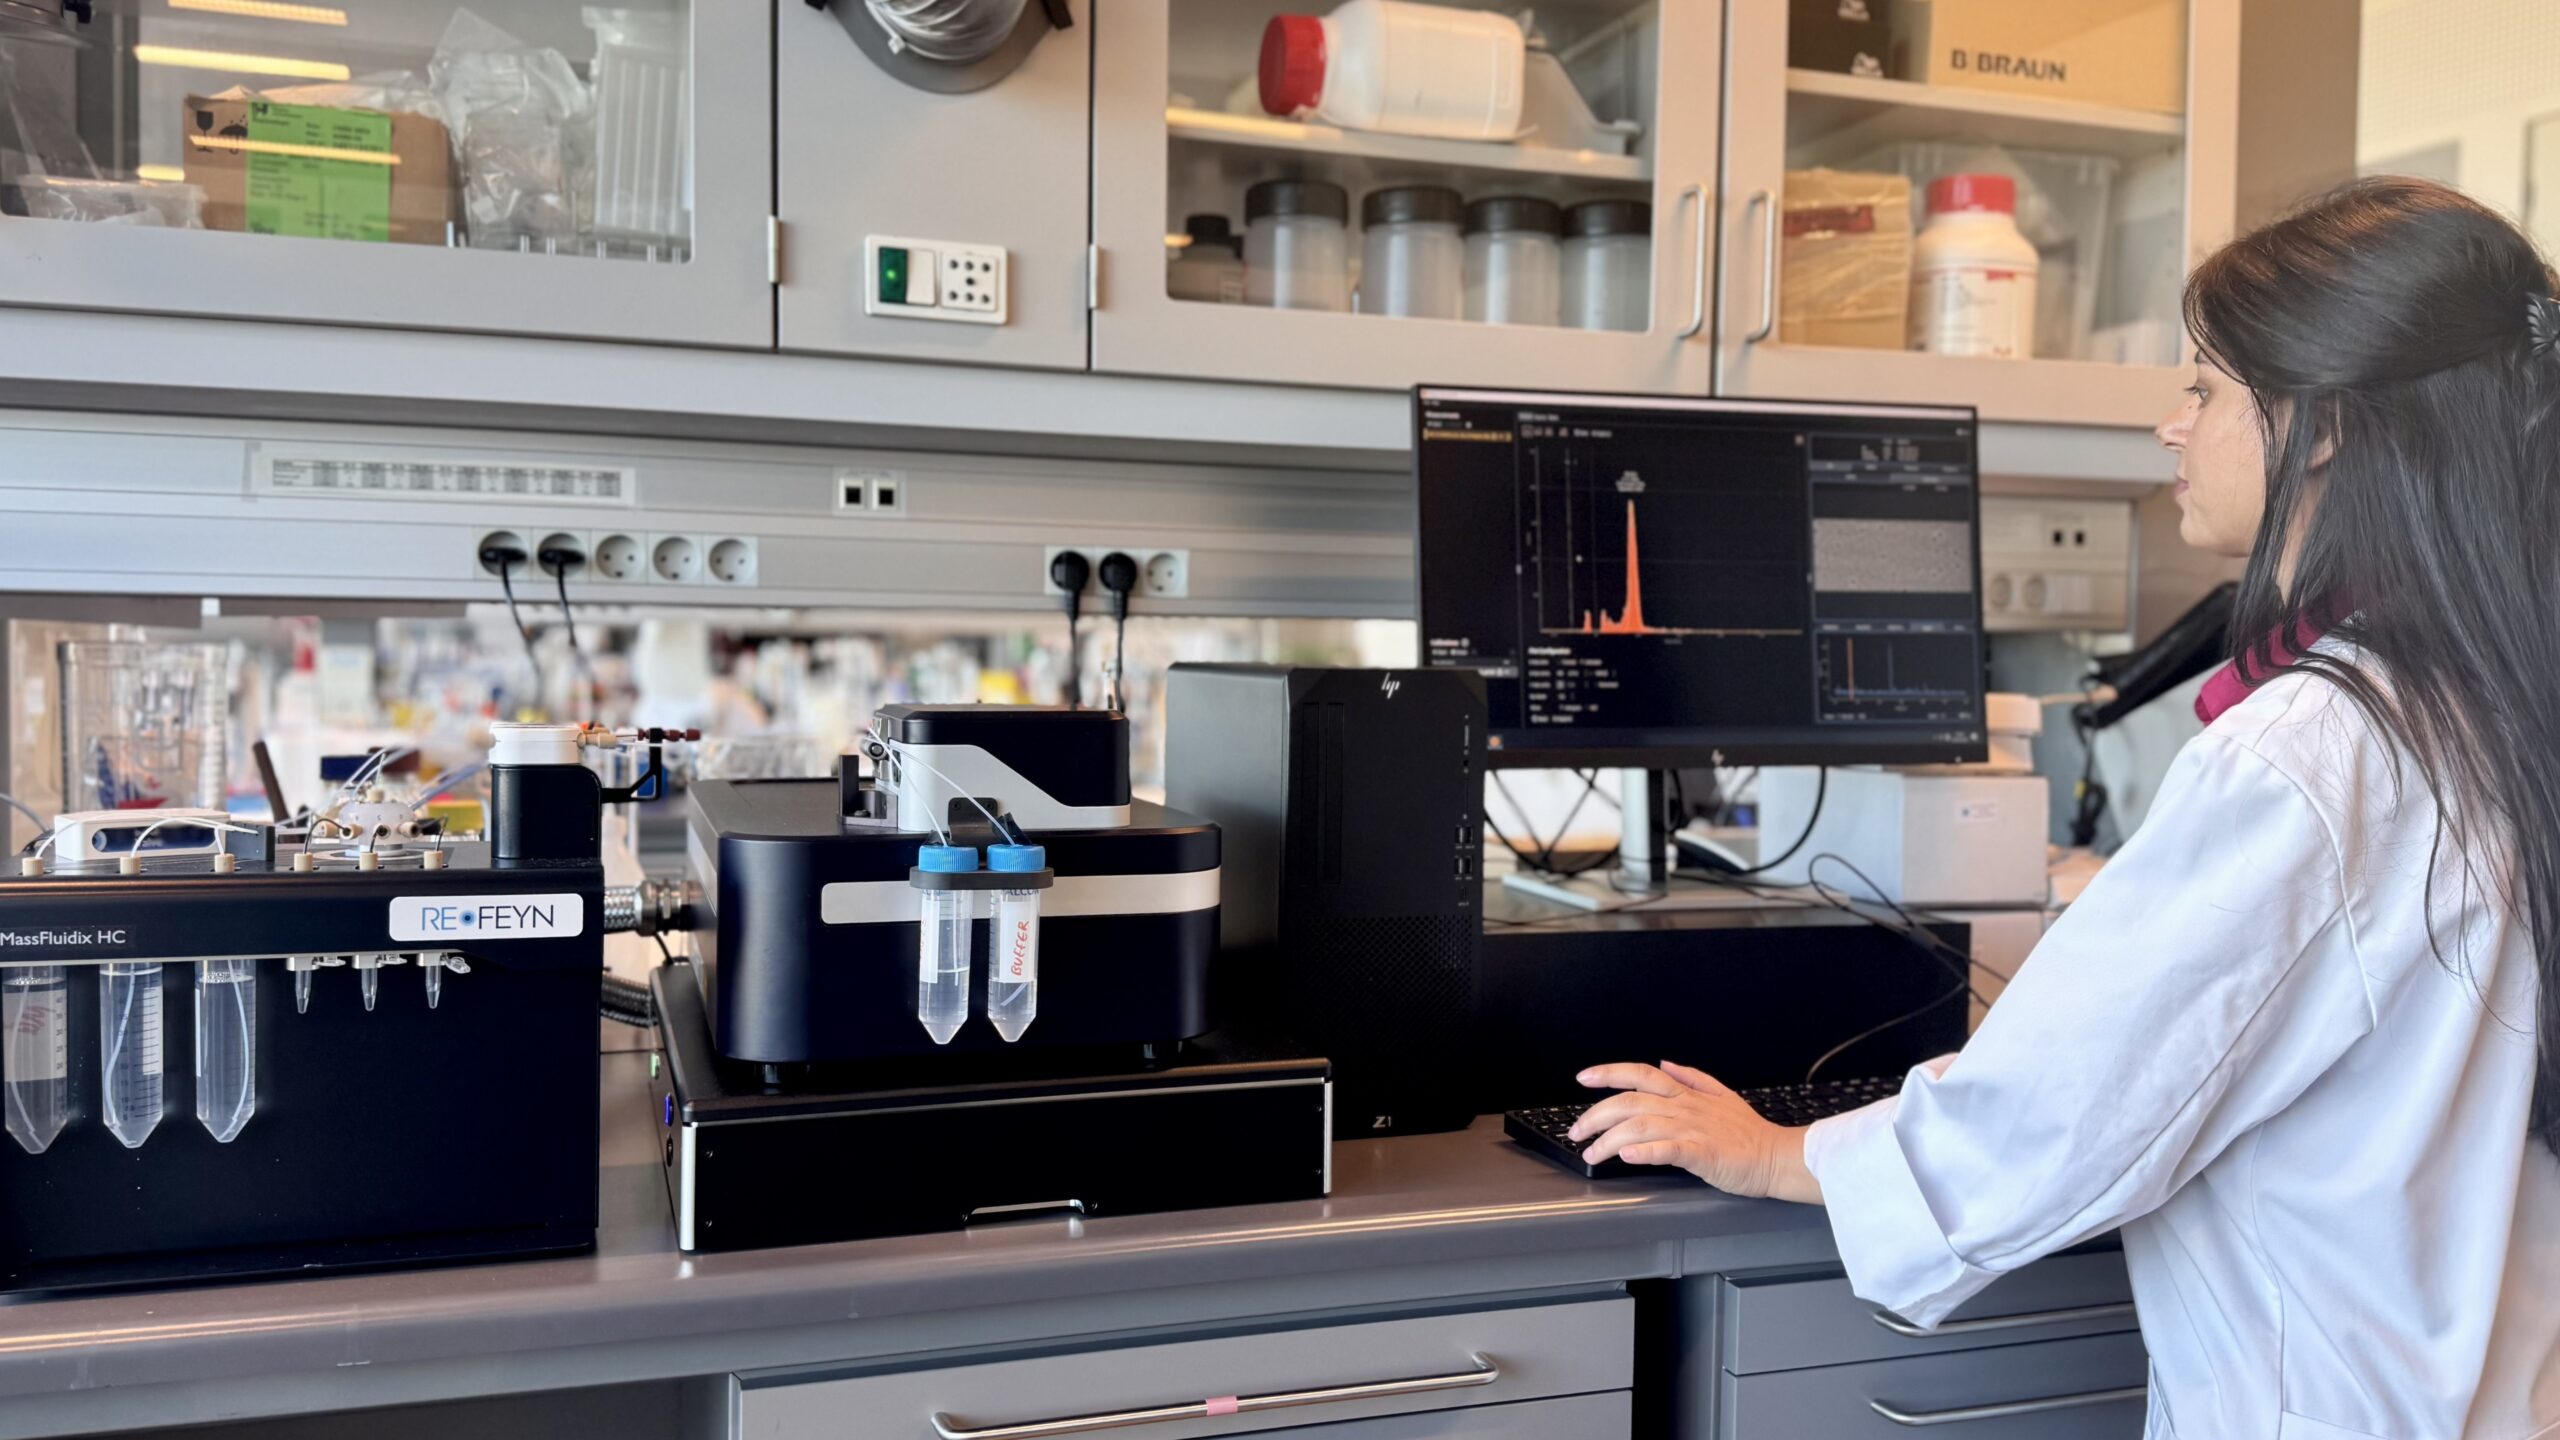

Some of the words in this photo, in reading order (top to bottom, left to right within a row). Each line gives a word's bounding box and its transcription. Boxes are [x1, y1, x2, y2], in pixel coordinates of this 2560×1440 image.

[1951, 50, 1968, 70] B
[1977, 53, 2066, 81] BRAUN
[1381, 671, 1401, 699] hp
[0, 930, 93, 946] MassFluidix
[98, 930, 126, 944] HC
